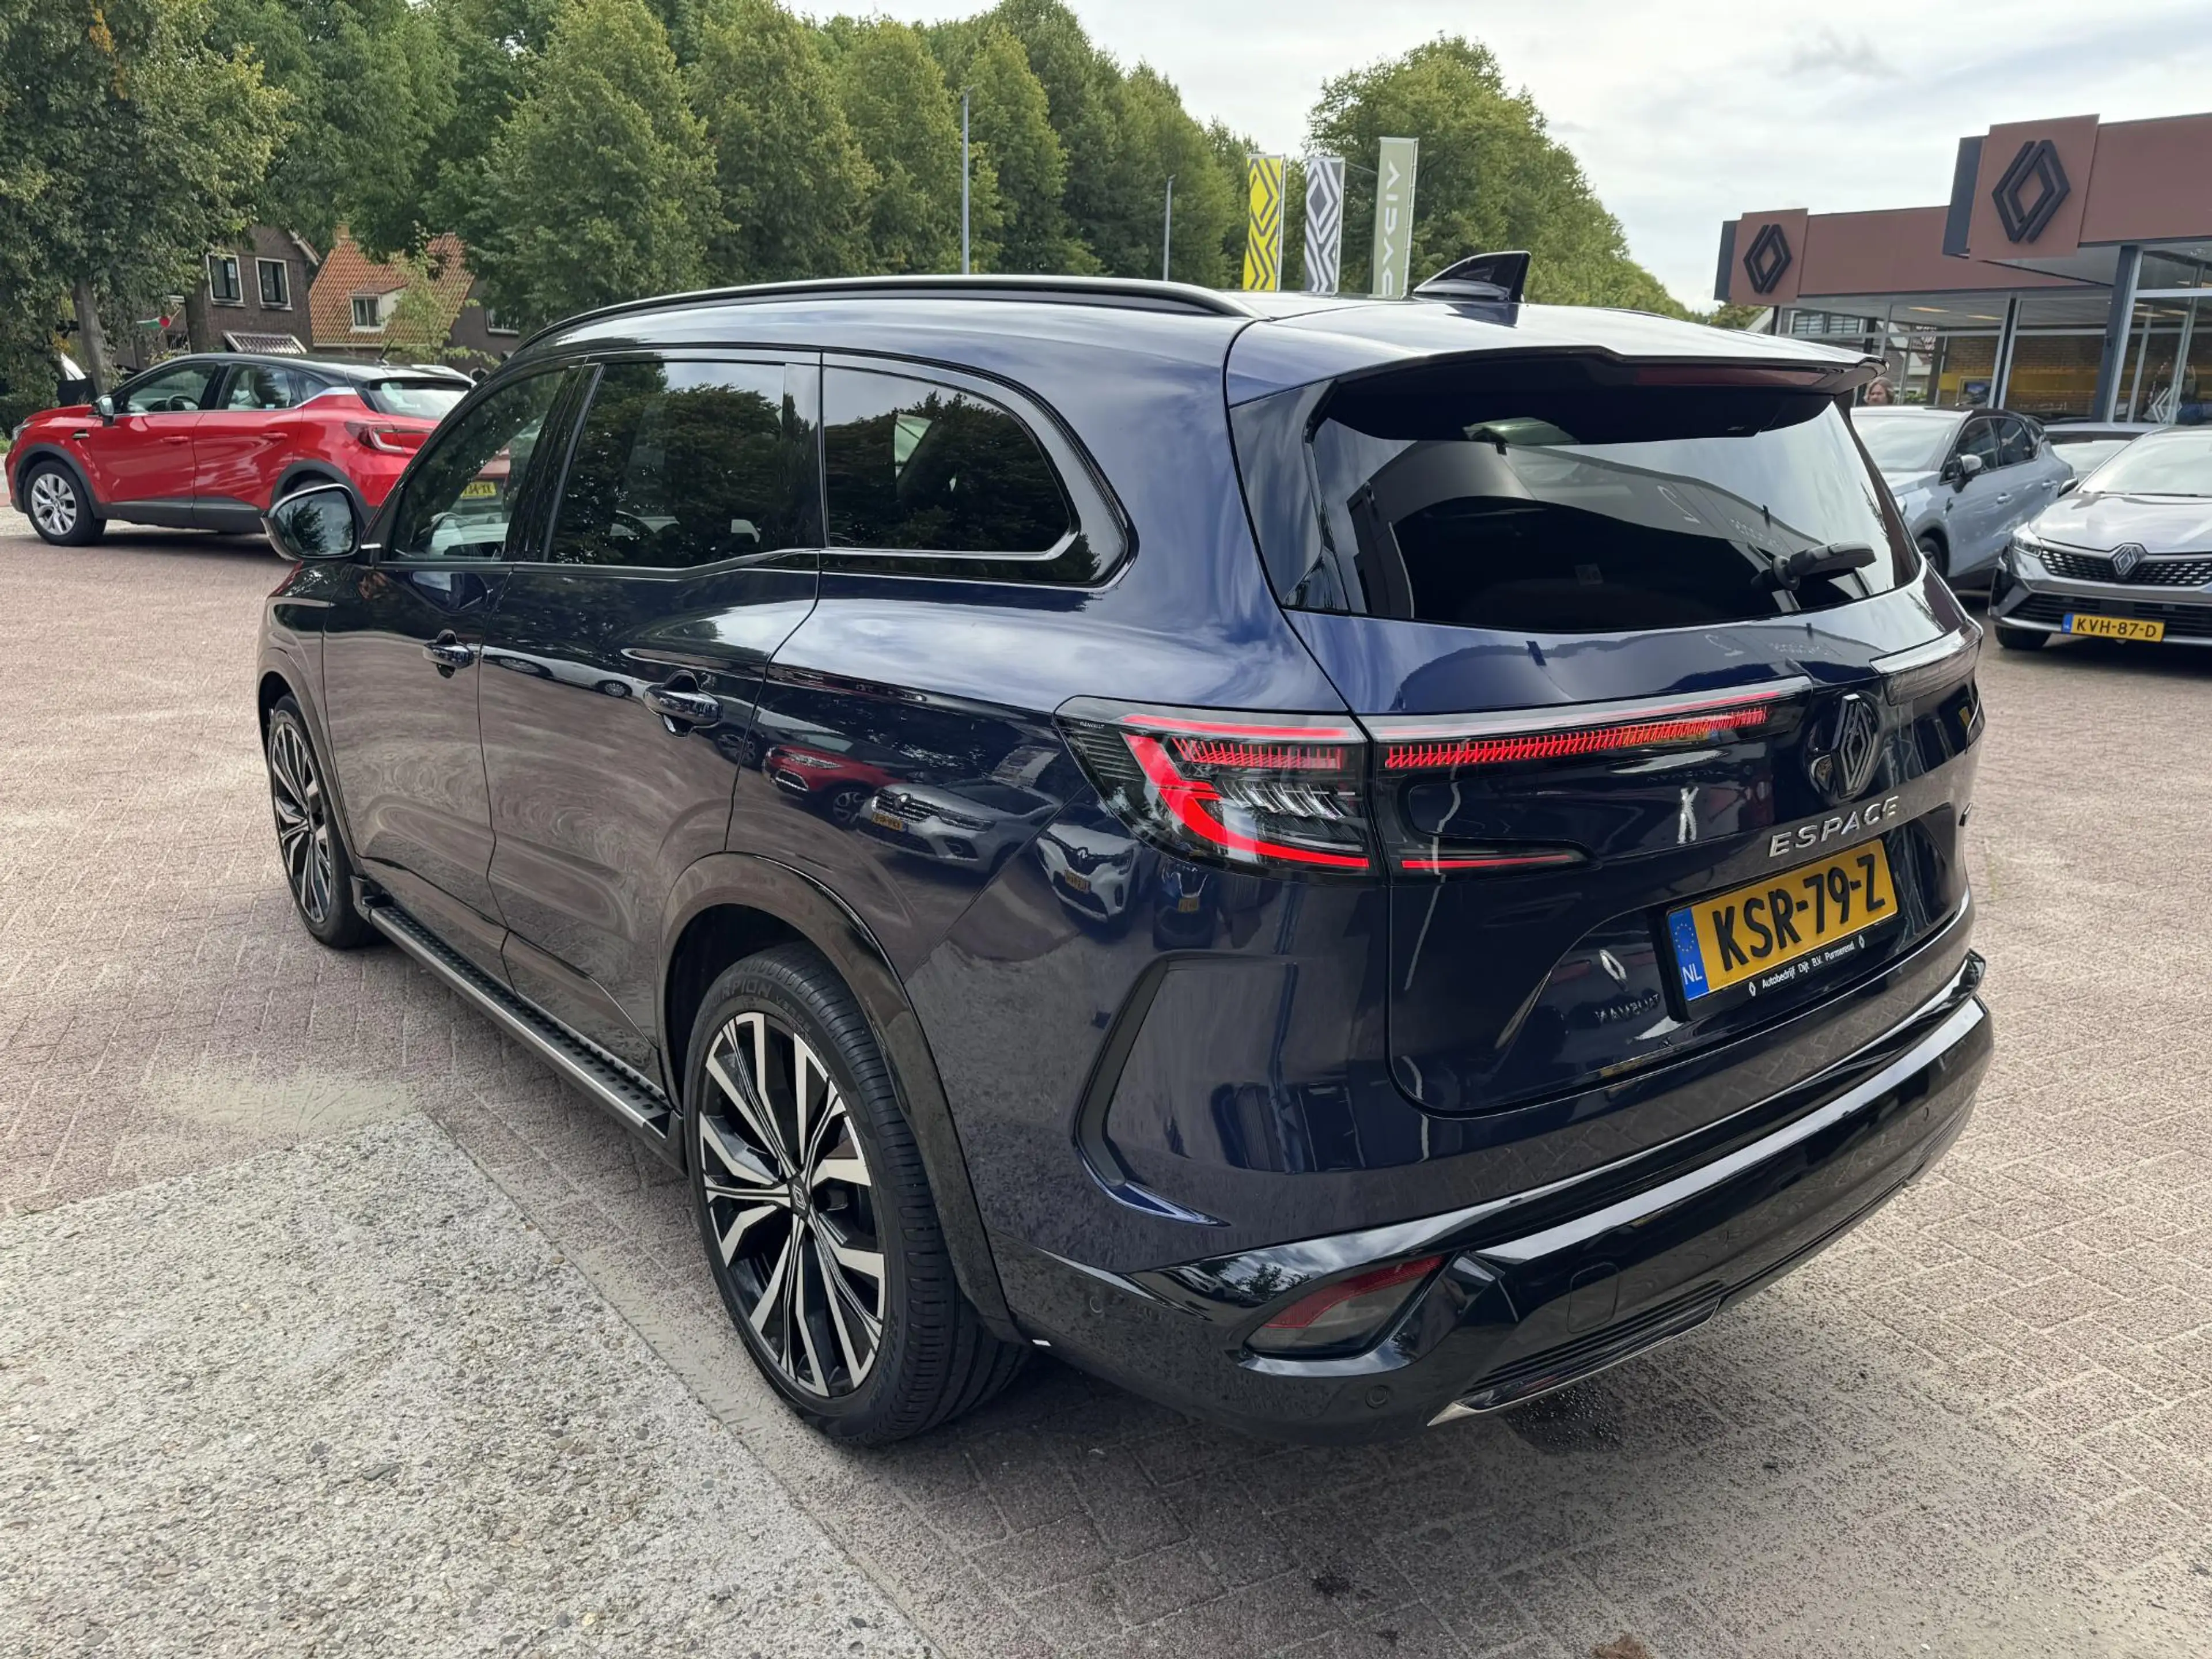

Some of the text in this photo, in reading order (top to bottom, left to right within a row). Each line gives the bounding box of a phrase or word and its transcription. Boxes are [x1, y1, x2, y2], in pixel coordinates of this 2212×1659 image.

[2077, 618, 2157, 638] KVH-87-D
[1768, 796, 1899, 857] ESPACE
[1711, 853, 1886, 972] KSR-79-Z
[1681, 963, 1703, 985] NL
